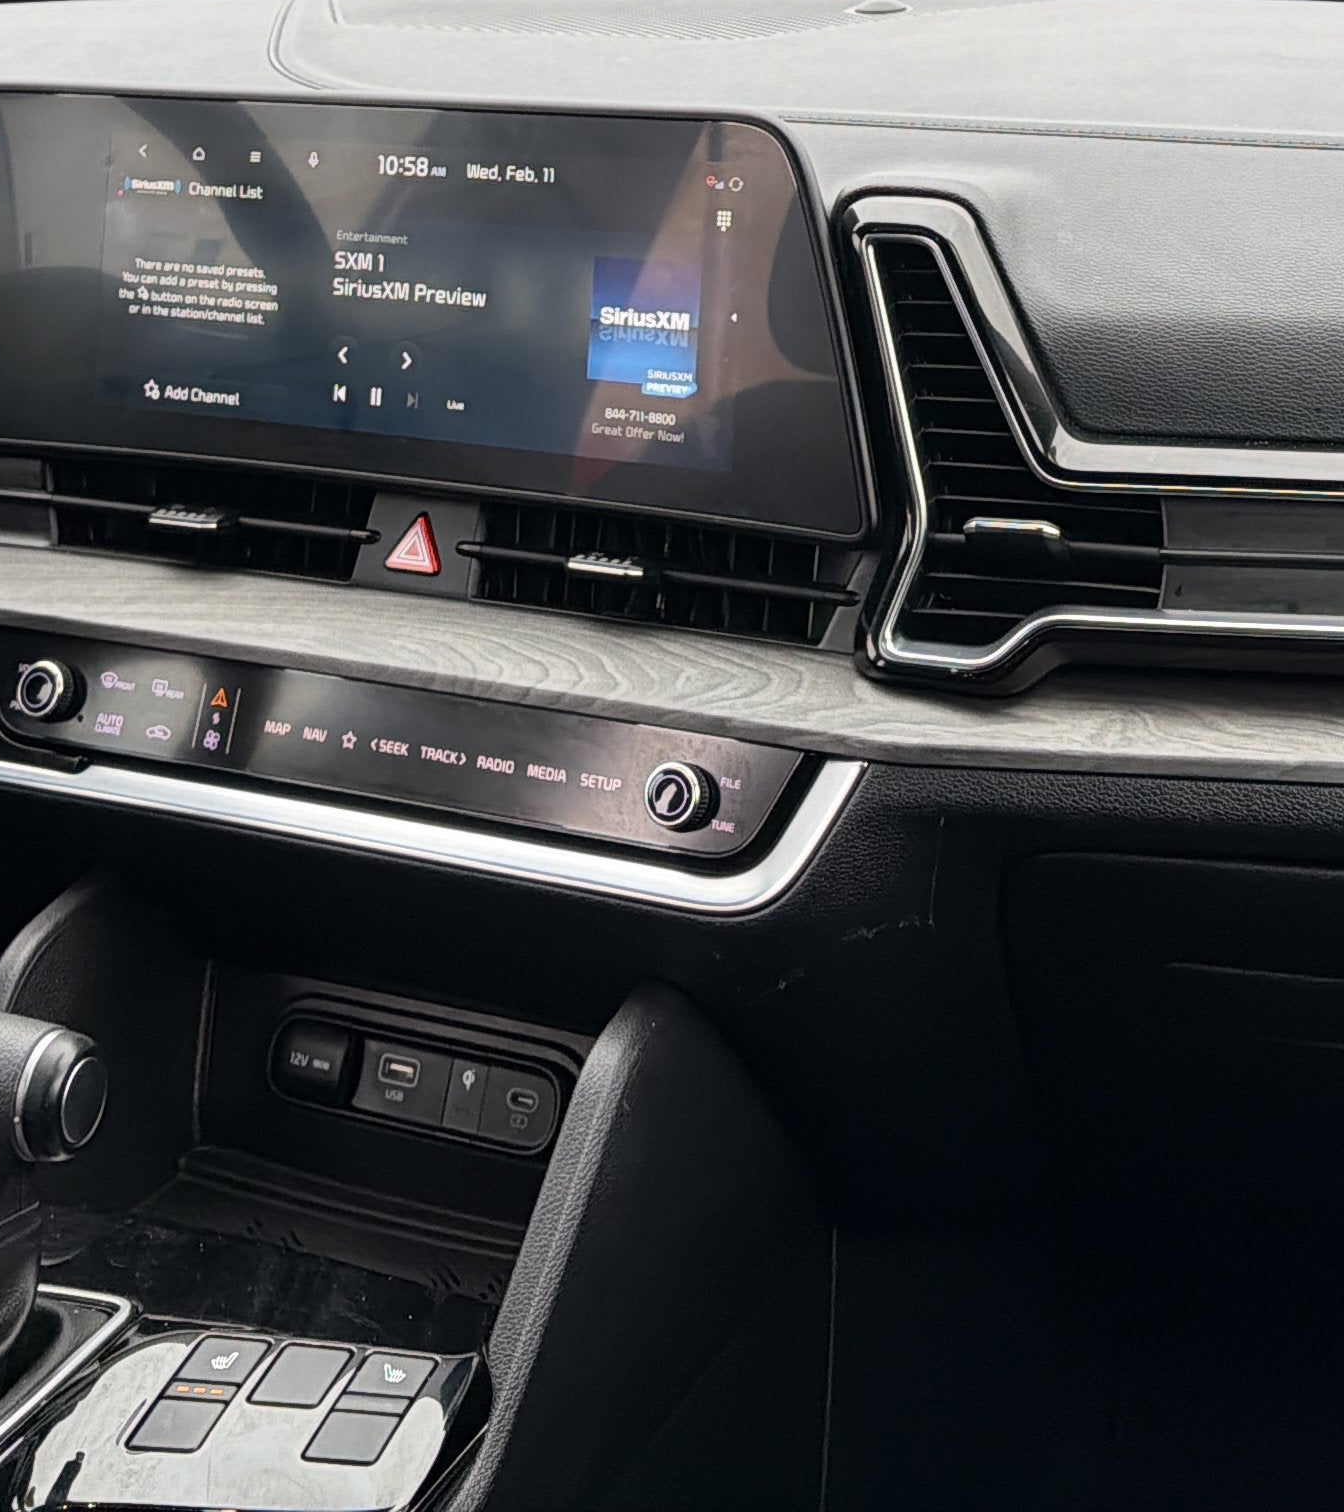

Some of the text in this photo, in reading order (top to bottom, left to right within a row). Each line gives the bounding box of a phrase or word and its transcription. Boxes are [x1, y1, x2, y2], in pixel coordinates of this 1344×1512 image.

[377, 155, 447, 178] 10:58 AM
[543, 167, 556, 184] 11
[188, 181, 238, 199] Channel
[239, 184, 264, 200] List
[336, 230, 408, 245] Entertainment
[135, 257, 266, 279] There are no saved presets.
[334, 251, 385, 272] SXM 1
[122, 271, 139, 283] You
[141, 274, 157, 284] can
[159, 274, 178, 286] add
[187, 278, 219, 289] preset
[221, 279, 234, 291] by
[235, 281, 278, 296] pressing
[332, 278, 487, 308] SiriusXM Preview
[118, 288, 279, 312] the button on the radio screen
[128, 304, 140, 314] or
[142, 304, 151, 315] in
[152, 304, 168, 317] the
[170, 306, 244, 323] station/channel
[599, 306, 690, 331] SiriusXM
[647, 369, 693, 383] SIRIUSXM
[164, 384, 241, 406] Add Channel
[604, 407, 676, 426] 844-711-8800
[591, 422, 685, 443] Great Offer Now!
[96, 712, 124, 727] AUTO
[264, 719, 291, 736] MAP
[302, 726, 328, 743] NAV
[476, 755, 515, 775] RADIO
[526, 763, 567, 784] MEDIA
[579, 773, 622, 792] SETUP
[720, 776, 741, 790] FILE
[711, 818, 736, 833] TUNE
[289, 1050, 310, 1068] 12V
[384, 1088, 404, 1102] USB
